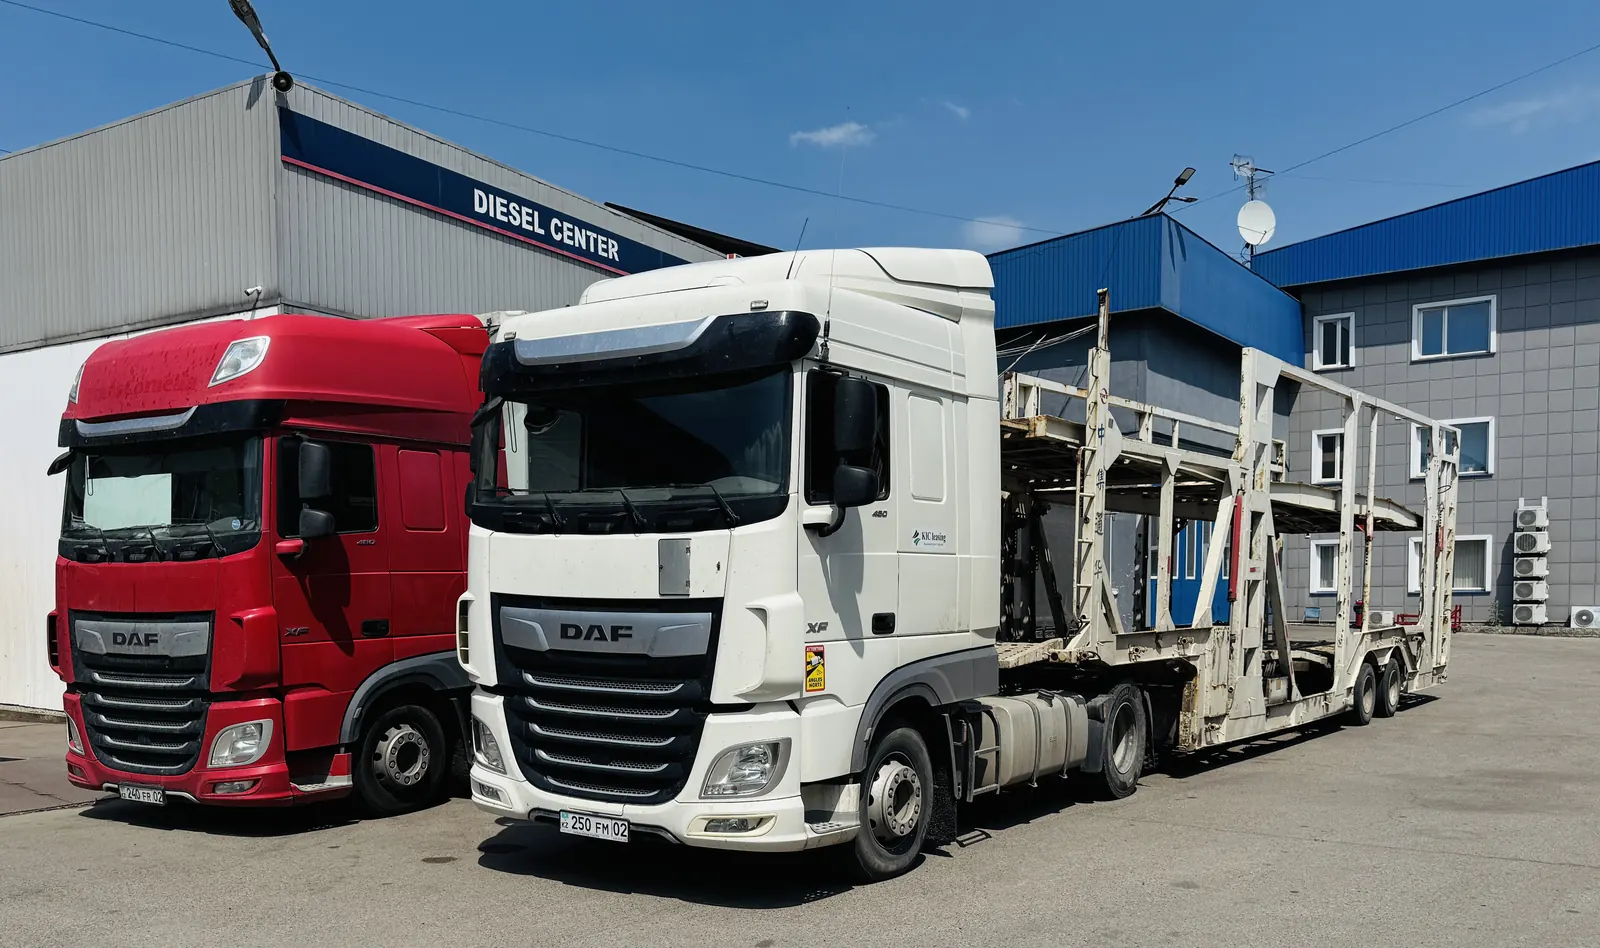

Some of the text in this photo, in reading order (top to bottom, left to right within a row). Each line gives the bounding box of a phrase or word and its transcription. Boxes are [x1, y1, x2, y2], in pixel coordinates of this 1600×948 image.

[474, 188, 619, 261] DIESEL CENTER
[932, 532, 946, 543] leasing
[284, 627, 310, 637] XF
[560, 623, 633, 642] DAF
[805, 622, 828, 634] XF
[112, 632, 159, 646] DAF
[153, 791, 163, 802] 02
[571, 815, 591, 832] 250
[595, 822, 610, 835] FM
[613, 822, 628, 838] 02
